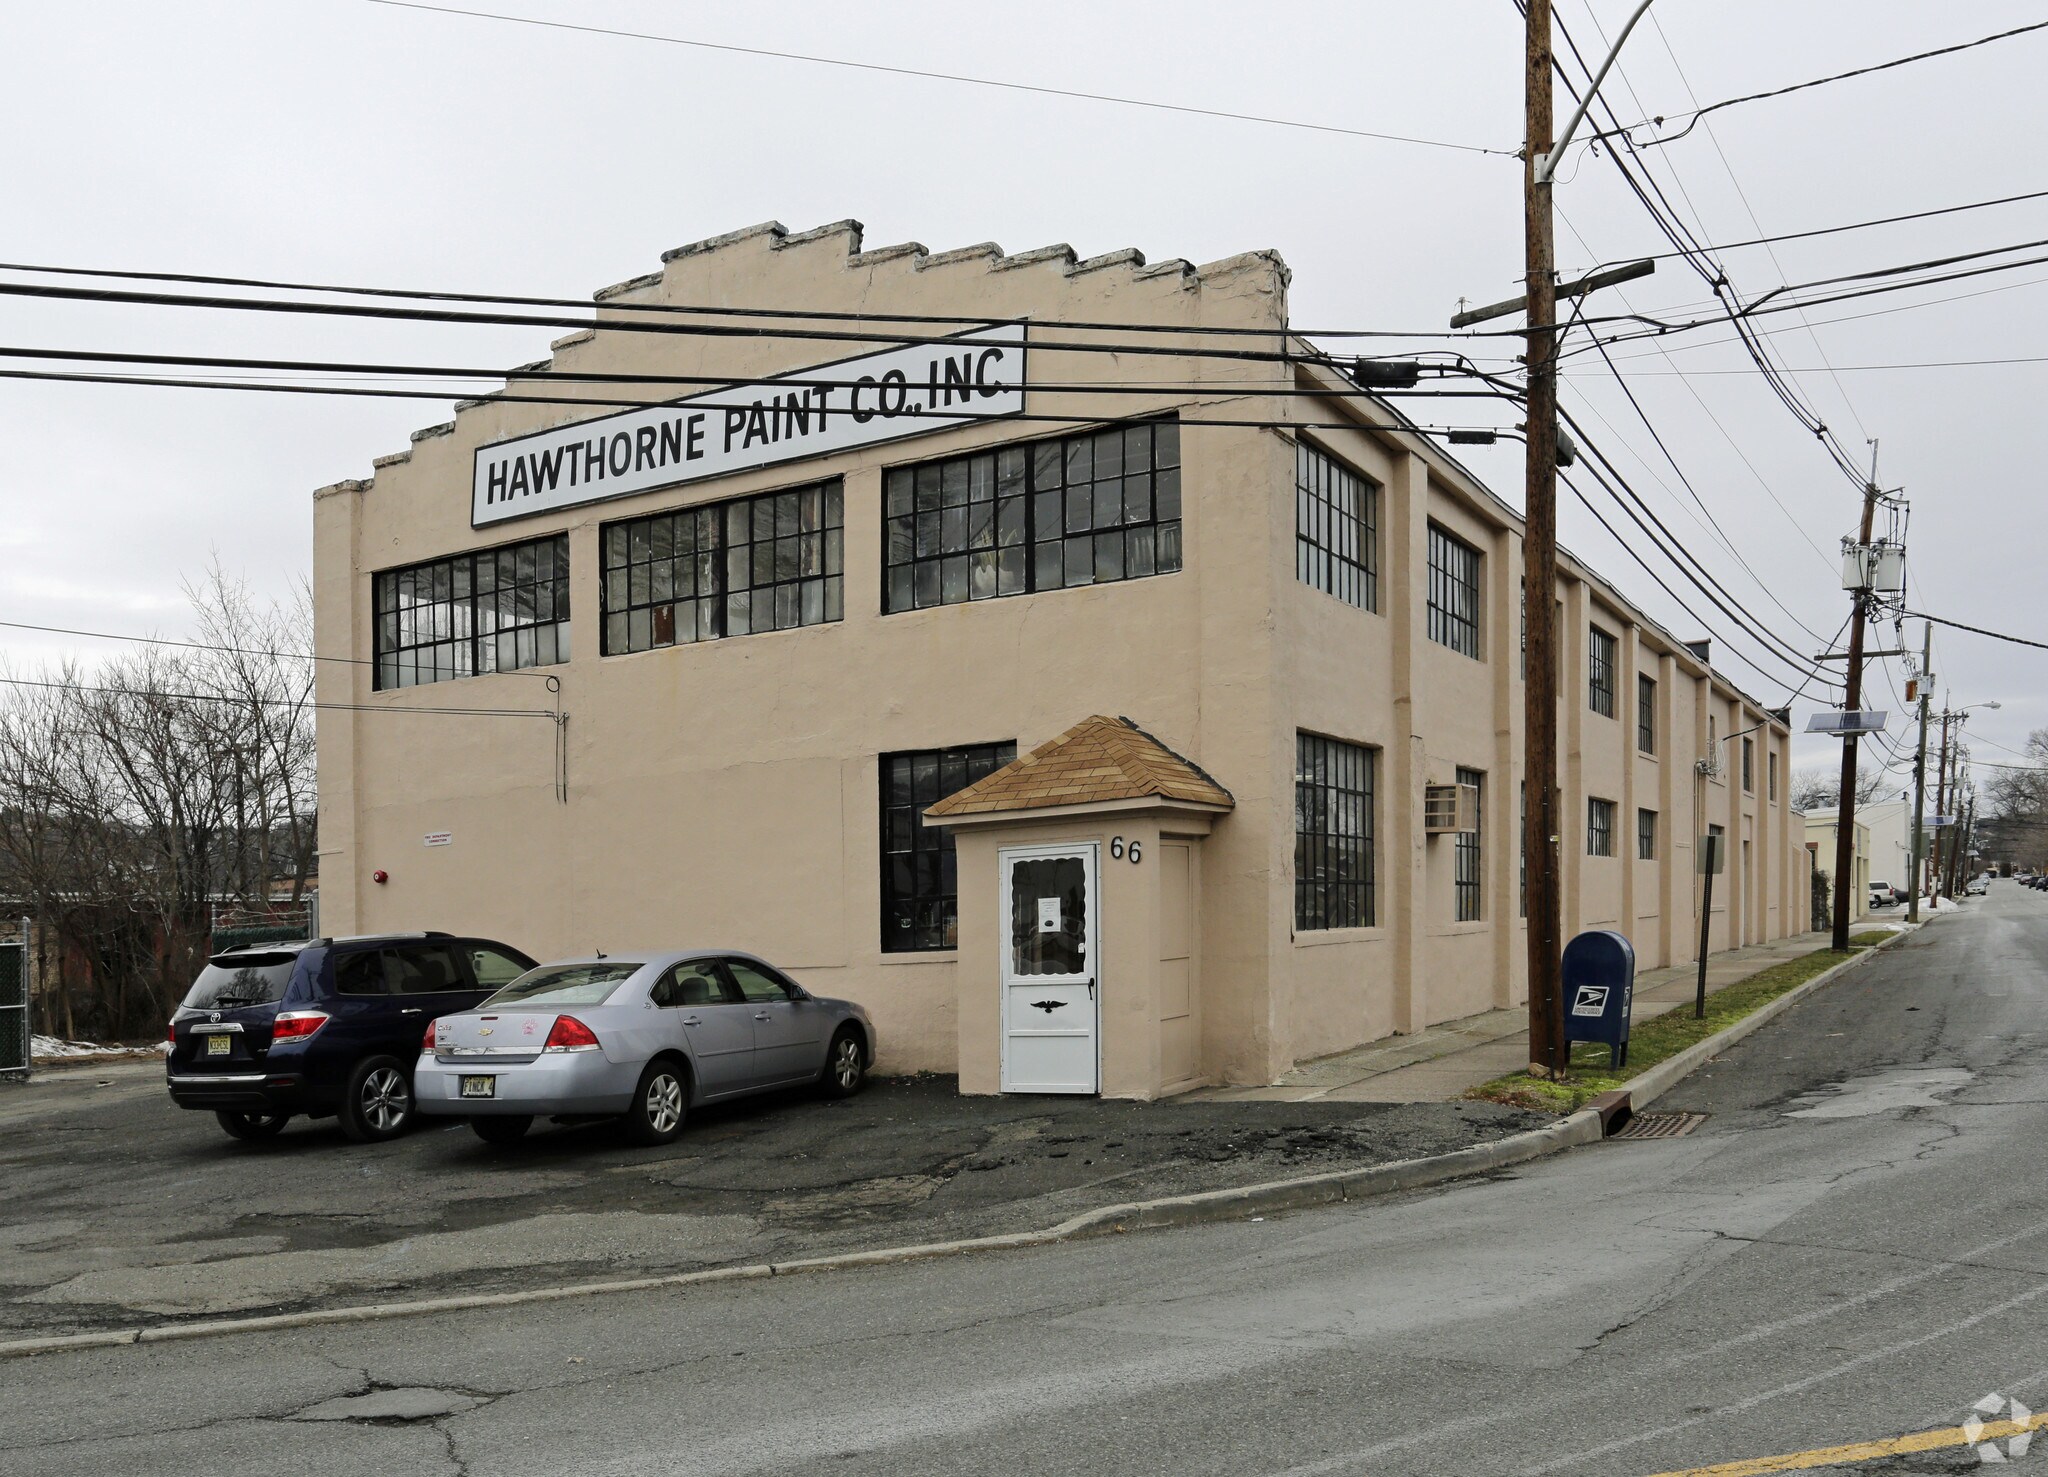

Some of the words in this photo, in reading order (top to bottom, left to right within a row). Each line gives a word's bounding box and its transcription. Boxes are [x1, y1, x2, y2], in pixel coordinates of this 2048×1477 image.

[487, 413, 705, 505] HAWTHORNE
[724, 385, 834, 454] PAINT
[1111, 836, 1142, 864] 66
